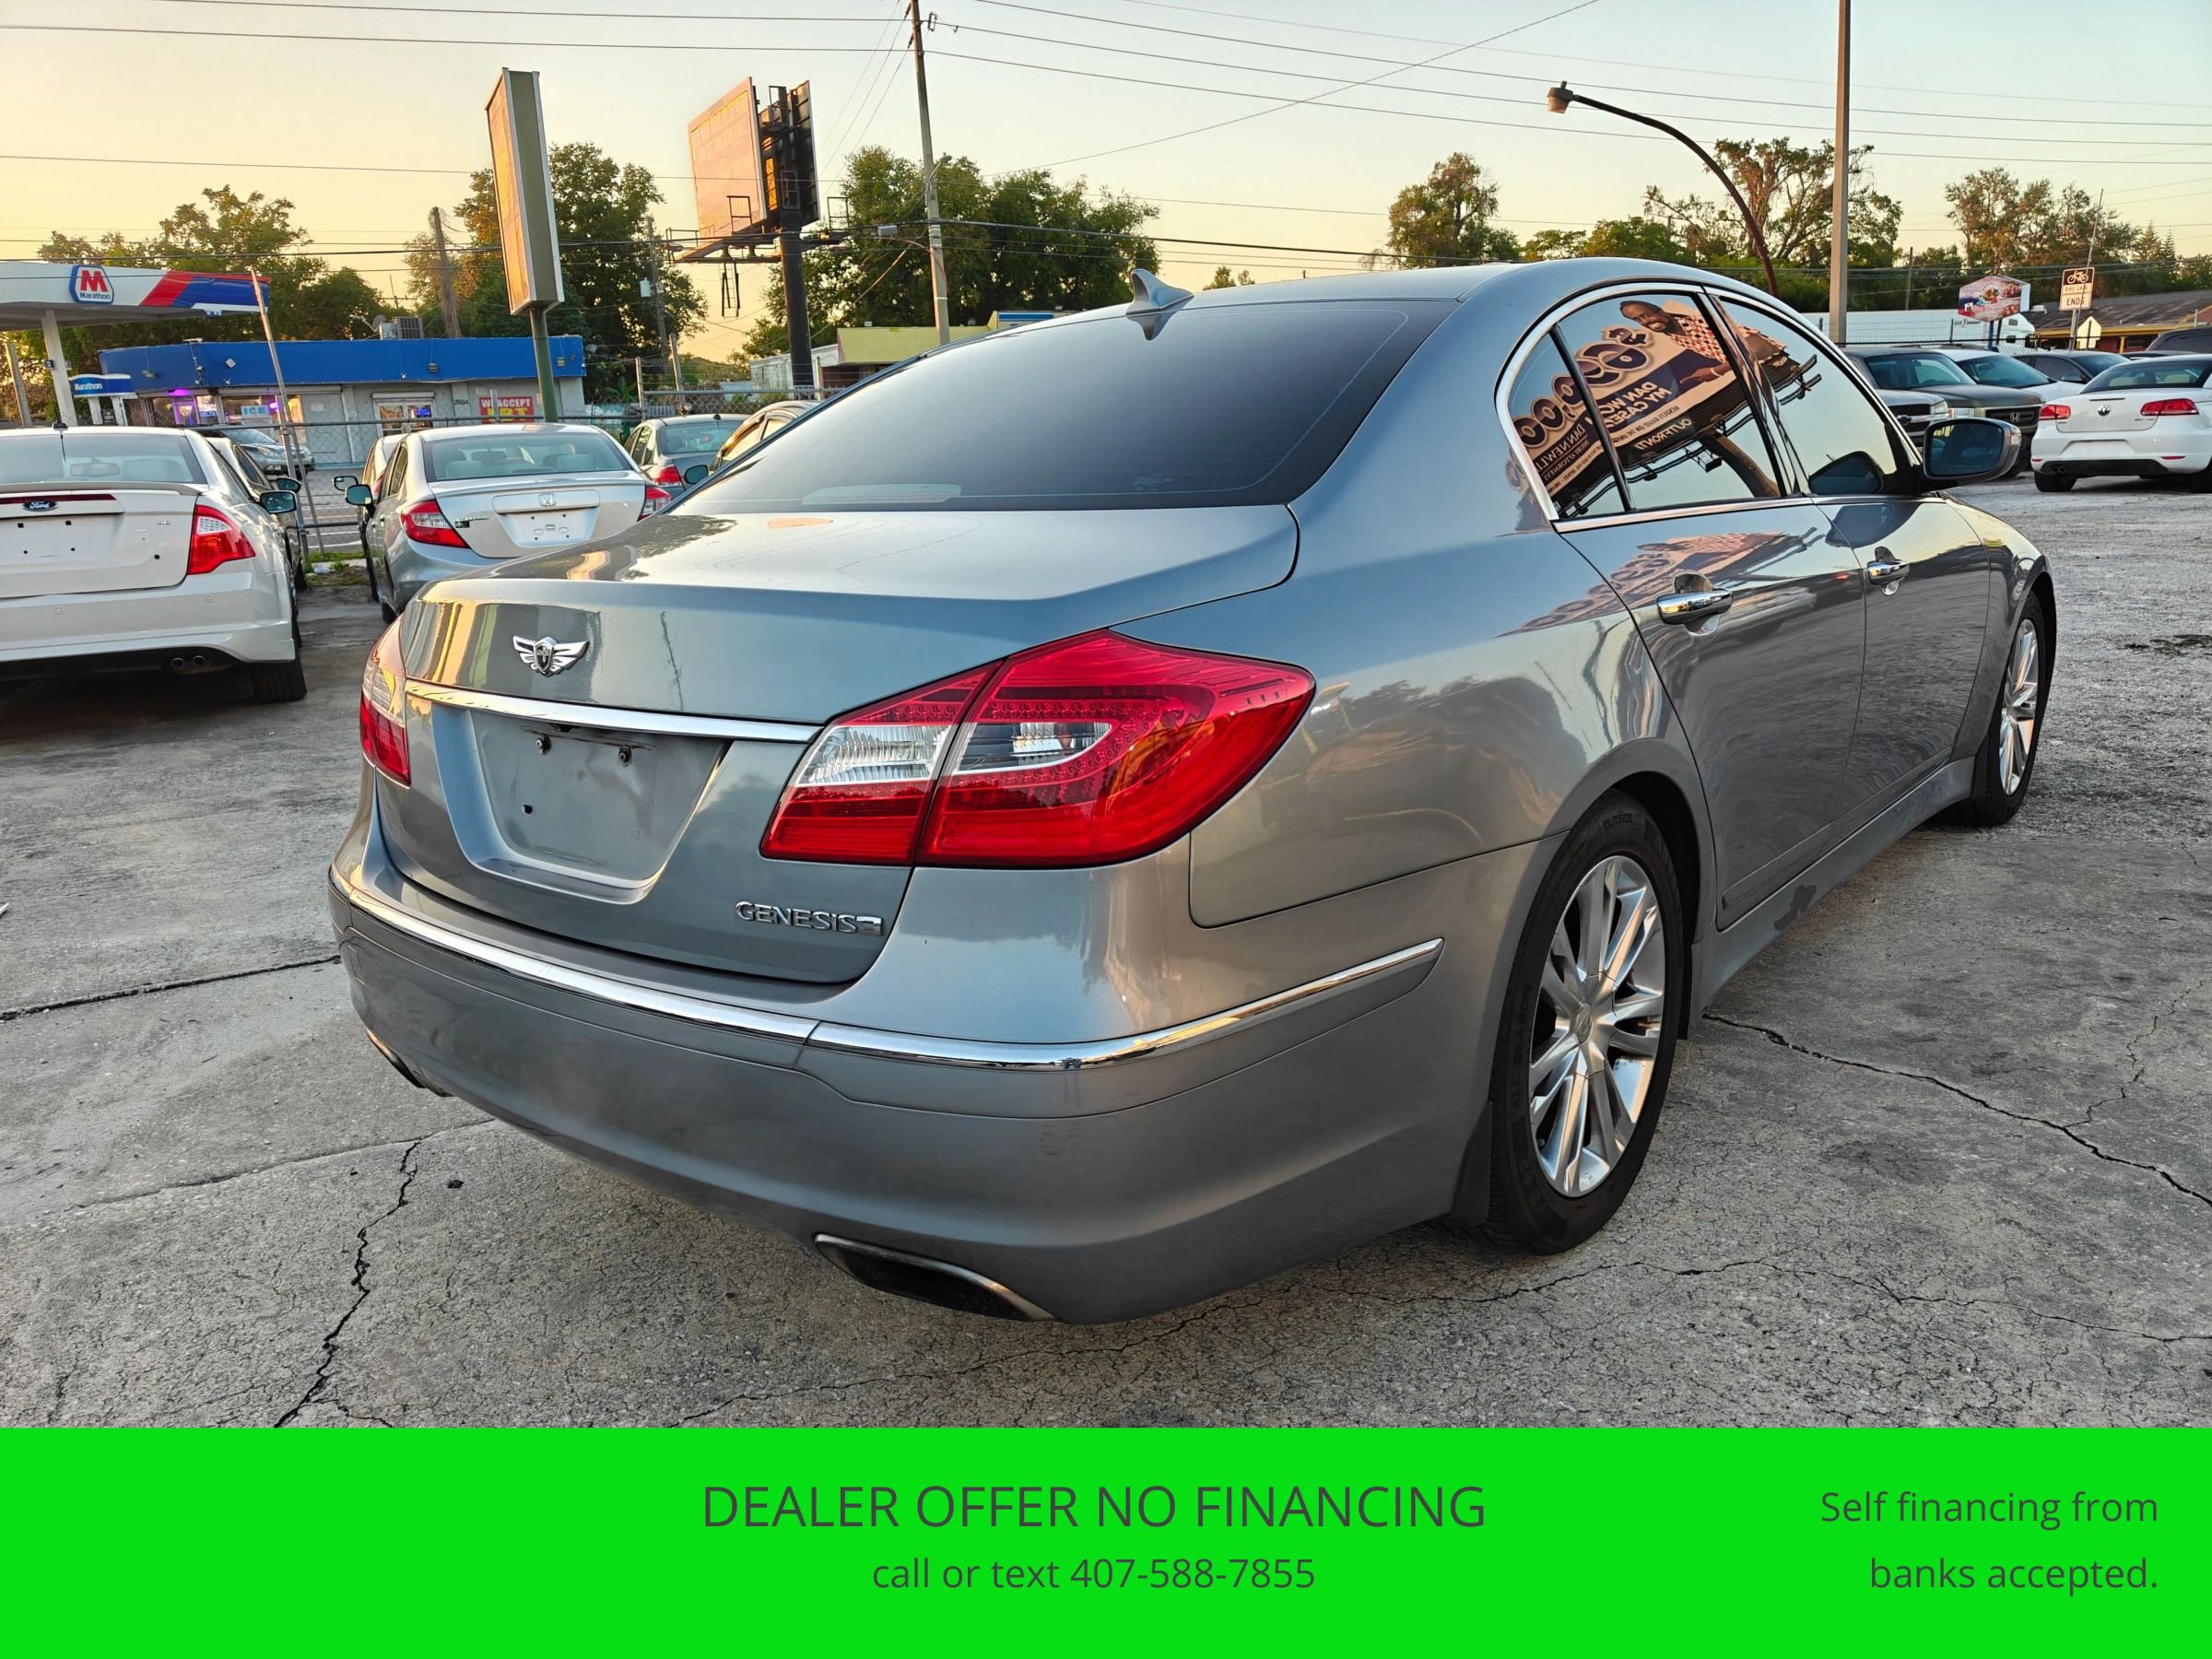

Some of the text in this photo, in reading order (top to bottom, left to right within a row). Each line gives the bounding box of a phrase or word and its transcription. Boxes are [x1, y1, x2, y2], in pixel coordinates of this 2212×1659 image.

[79, 292, 111, 300] Marathon
[2066, 297, 2085, 306] ENDS
[74, 382, 103, 391] Marathon
[29, 501, 50, 510] Ford
[735, 900, 857, 934] GENESIS
